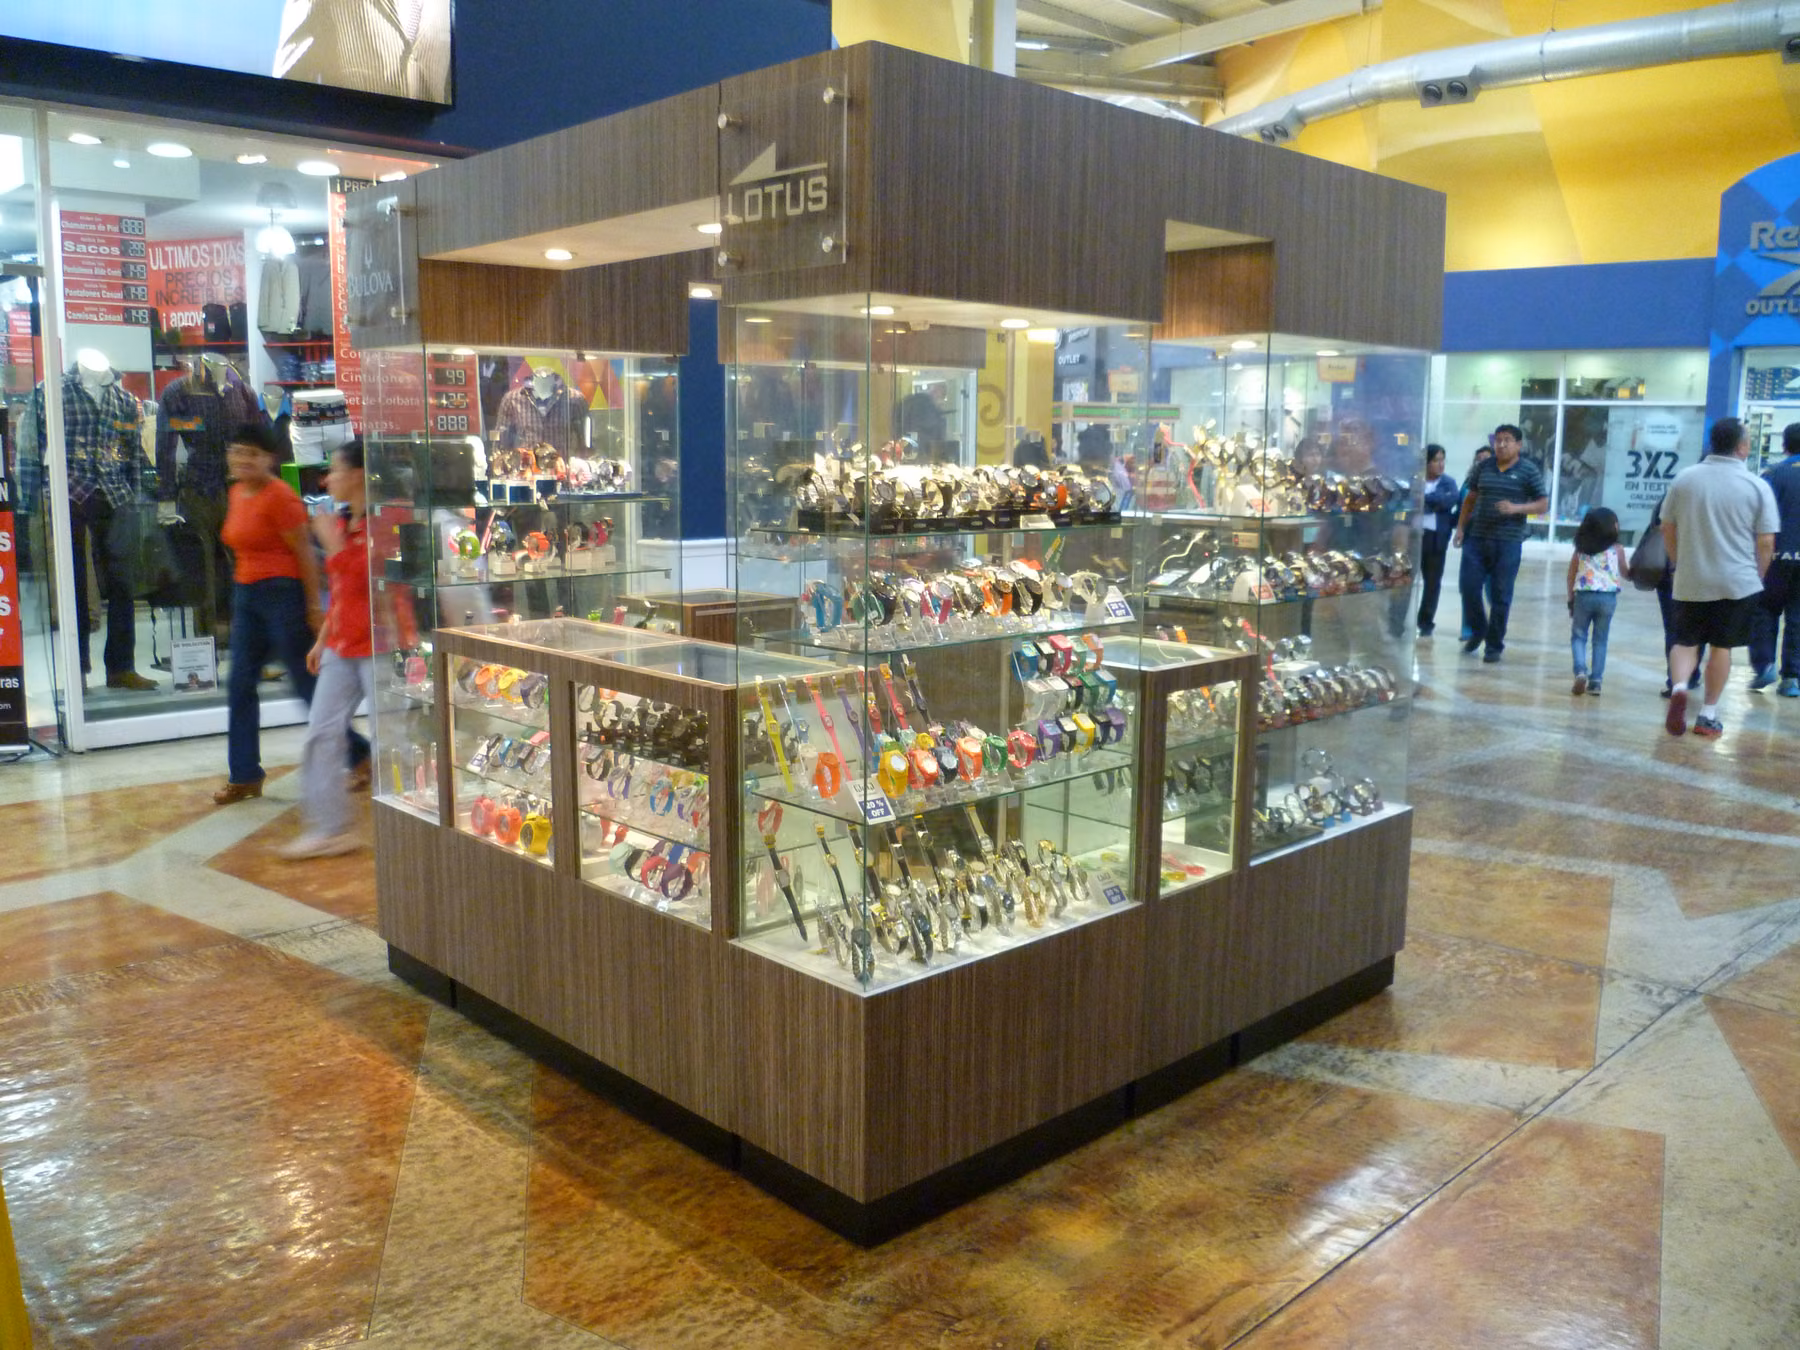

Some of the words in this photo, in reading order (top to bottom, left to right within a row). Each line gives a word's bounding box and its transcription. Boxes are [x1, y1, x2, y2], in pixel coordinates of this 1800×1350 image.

[724, 175, 828, 225] LOTUS
[63, 240, 121, 255] Sacos
[213, 240, 245, 267] DIAS
[165, 269, 233, 289] PRECIOS
[348, 272, 394, 298] BULOVA
[437, 415, 468, 432] 888
[1624, 450, 1680, 480] 3X2
[871, 808, 885, 817] OFF
